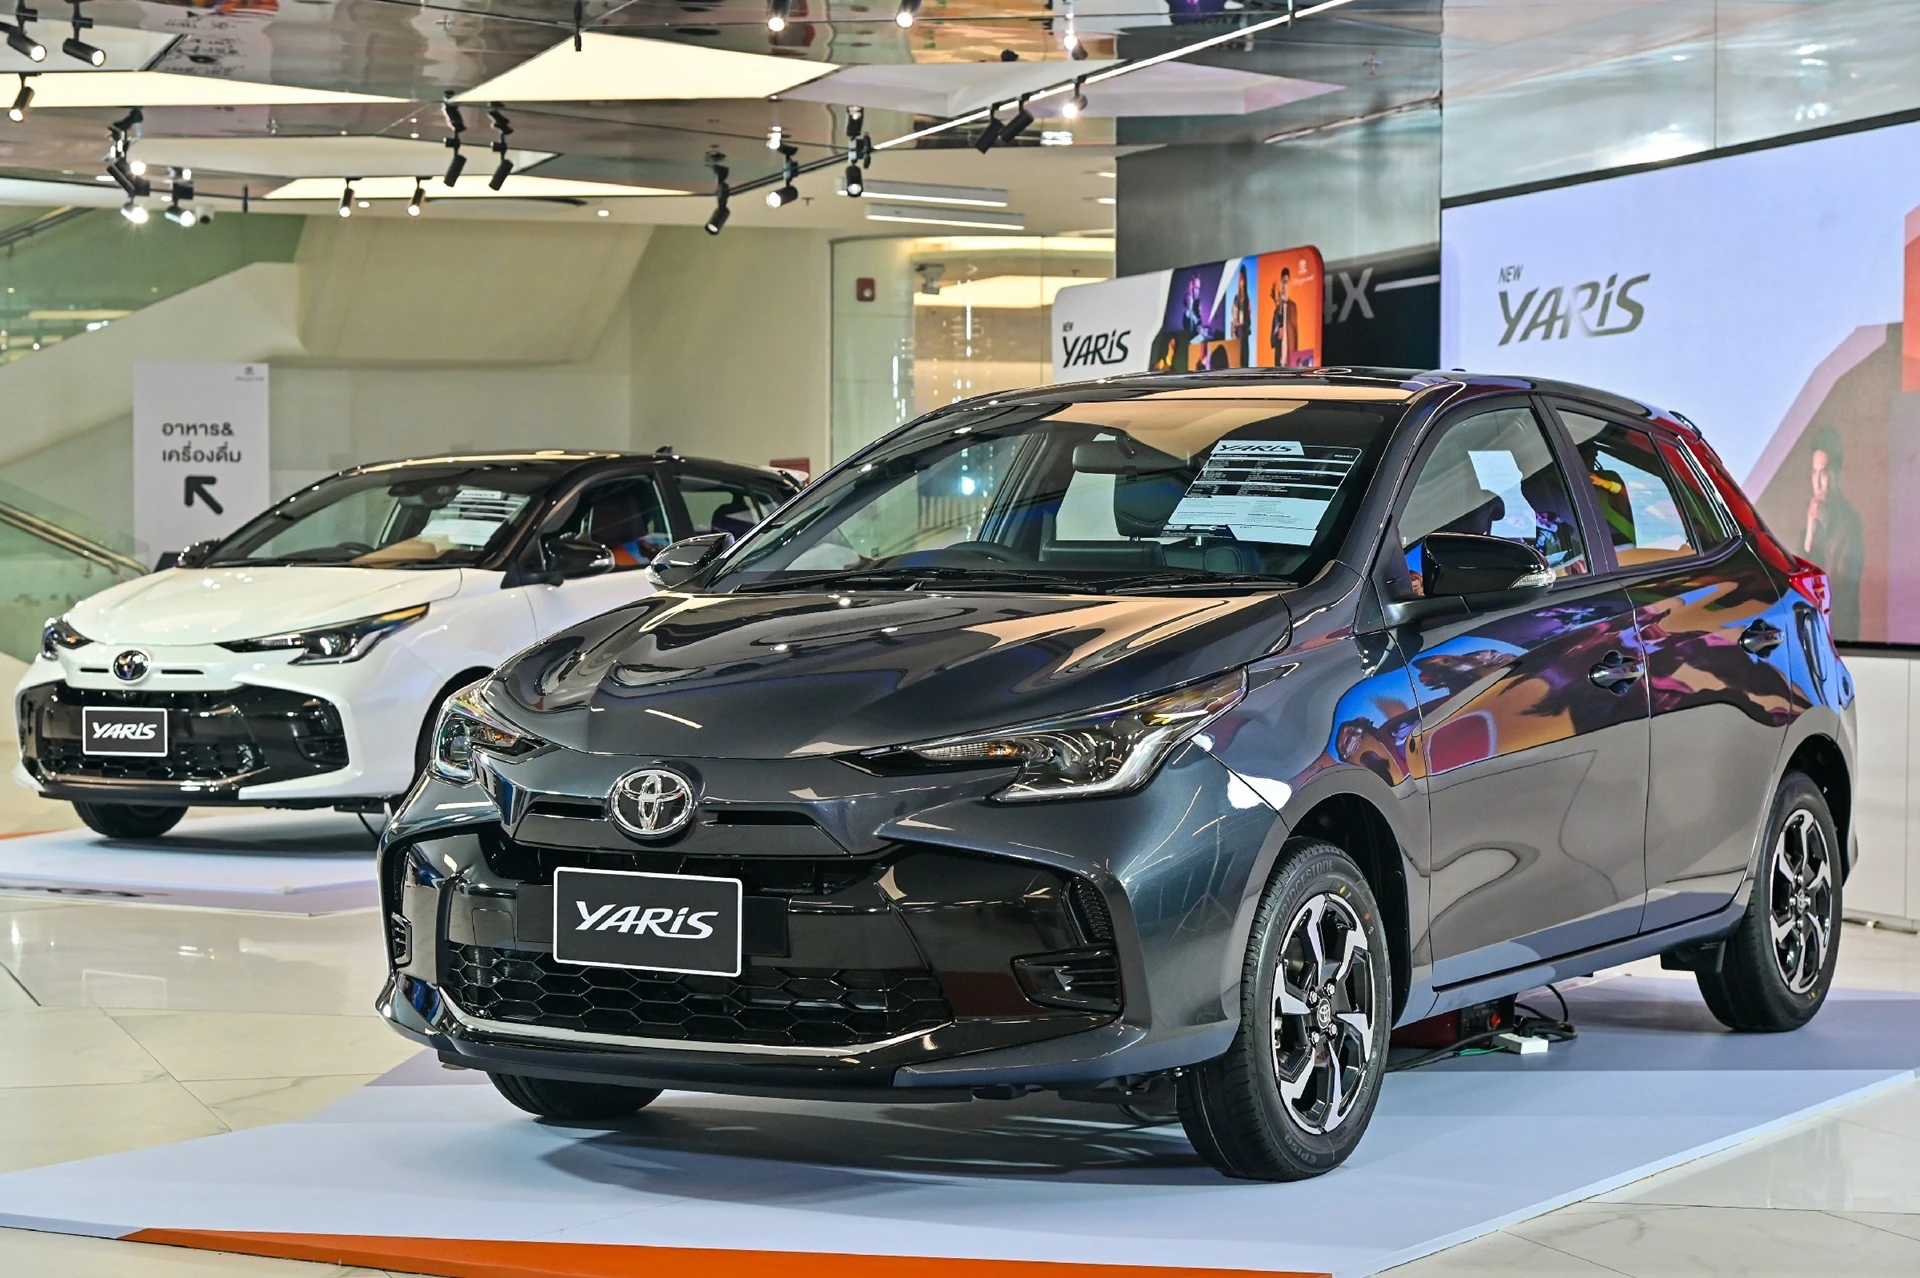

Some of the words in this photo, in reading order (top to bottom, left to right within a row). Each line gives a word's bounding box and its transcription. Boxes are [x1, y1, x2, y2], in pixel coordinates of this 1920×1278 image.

[1498, 265, 1523, 283] NEW
[161, 421, 235, 437] อาหาร&
[161, 440, 242, 463] เครื่องดื่ม
